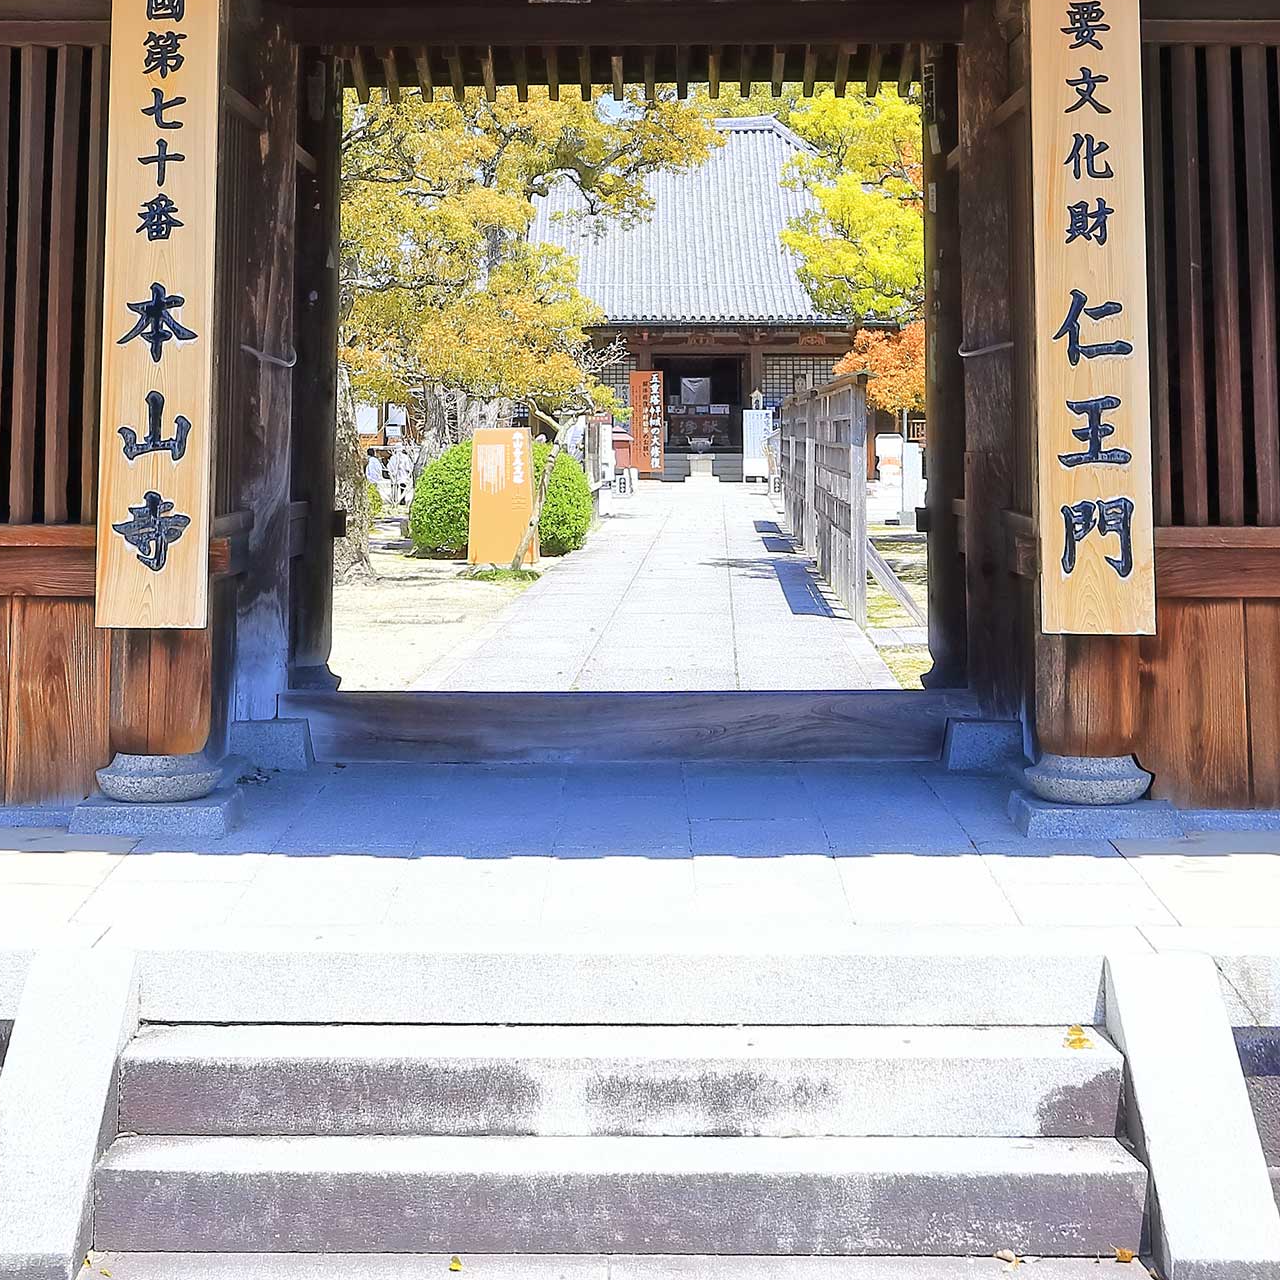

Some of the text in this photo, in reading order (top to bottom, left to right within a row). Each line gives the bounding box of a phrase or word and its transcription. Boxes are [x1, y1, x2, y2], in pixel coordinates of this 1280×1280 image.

[113, 282, 198, 571] 本山寺
[1051, 287, 1135, 580] 仁王門
